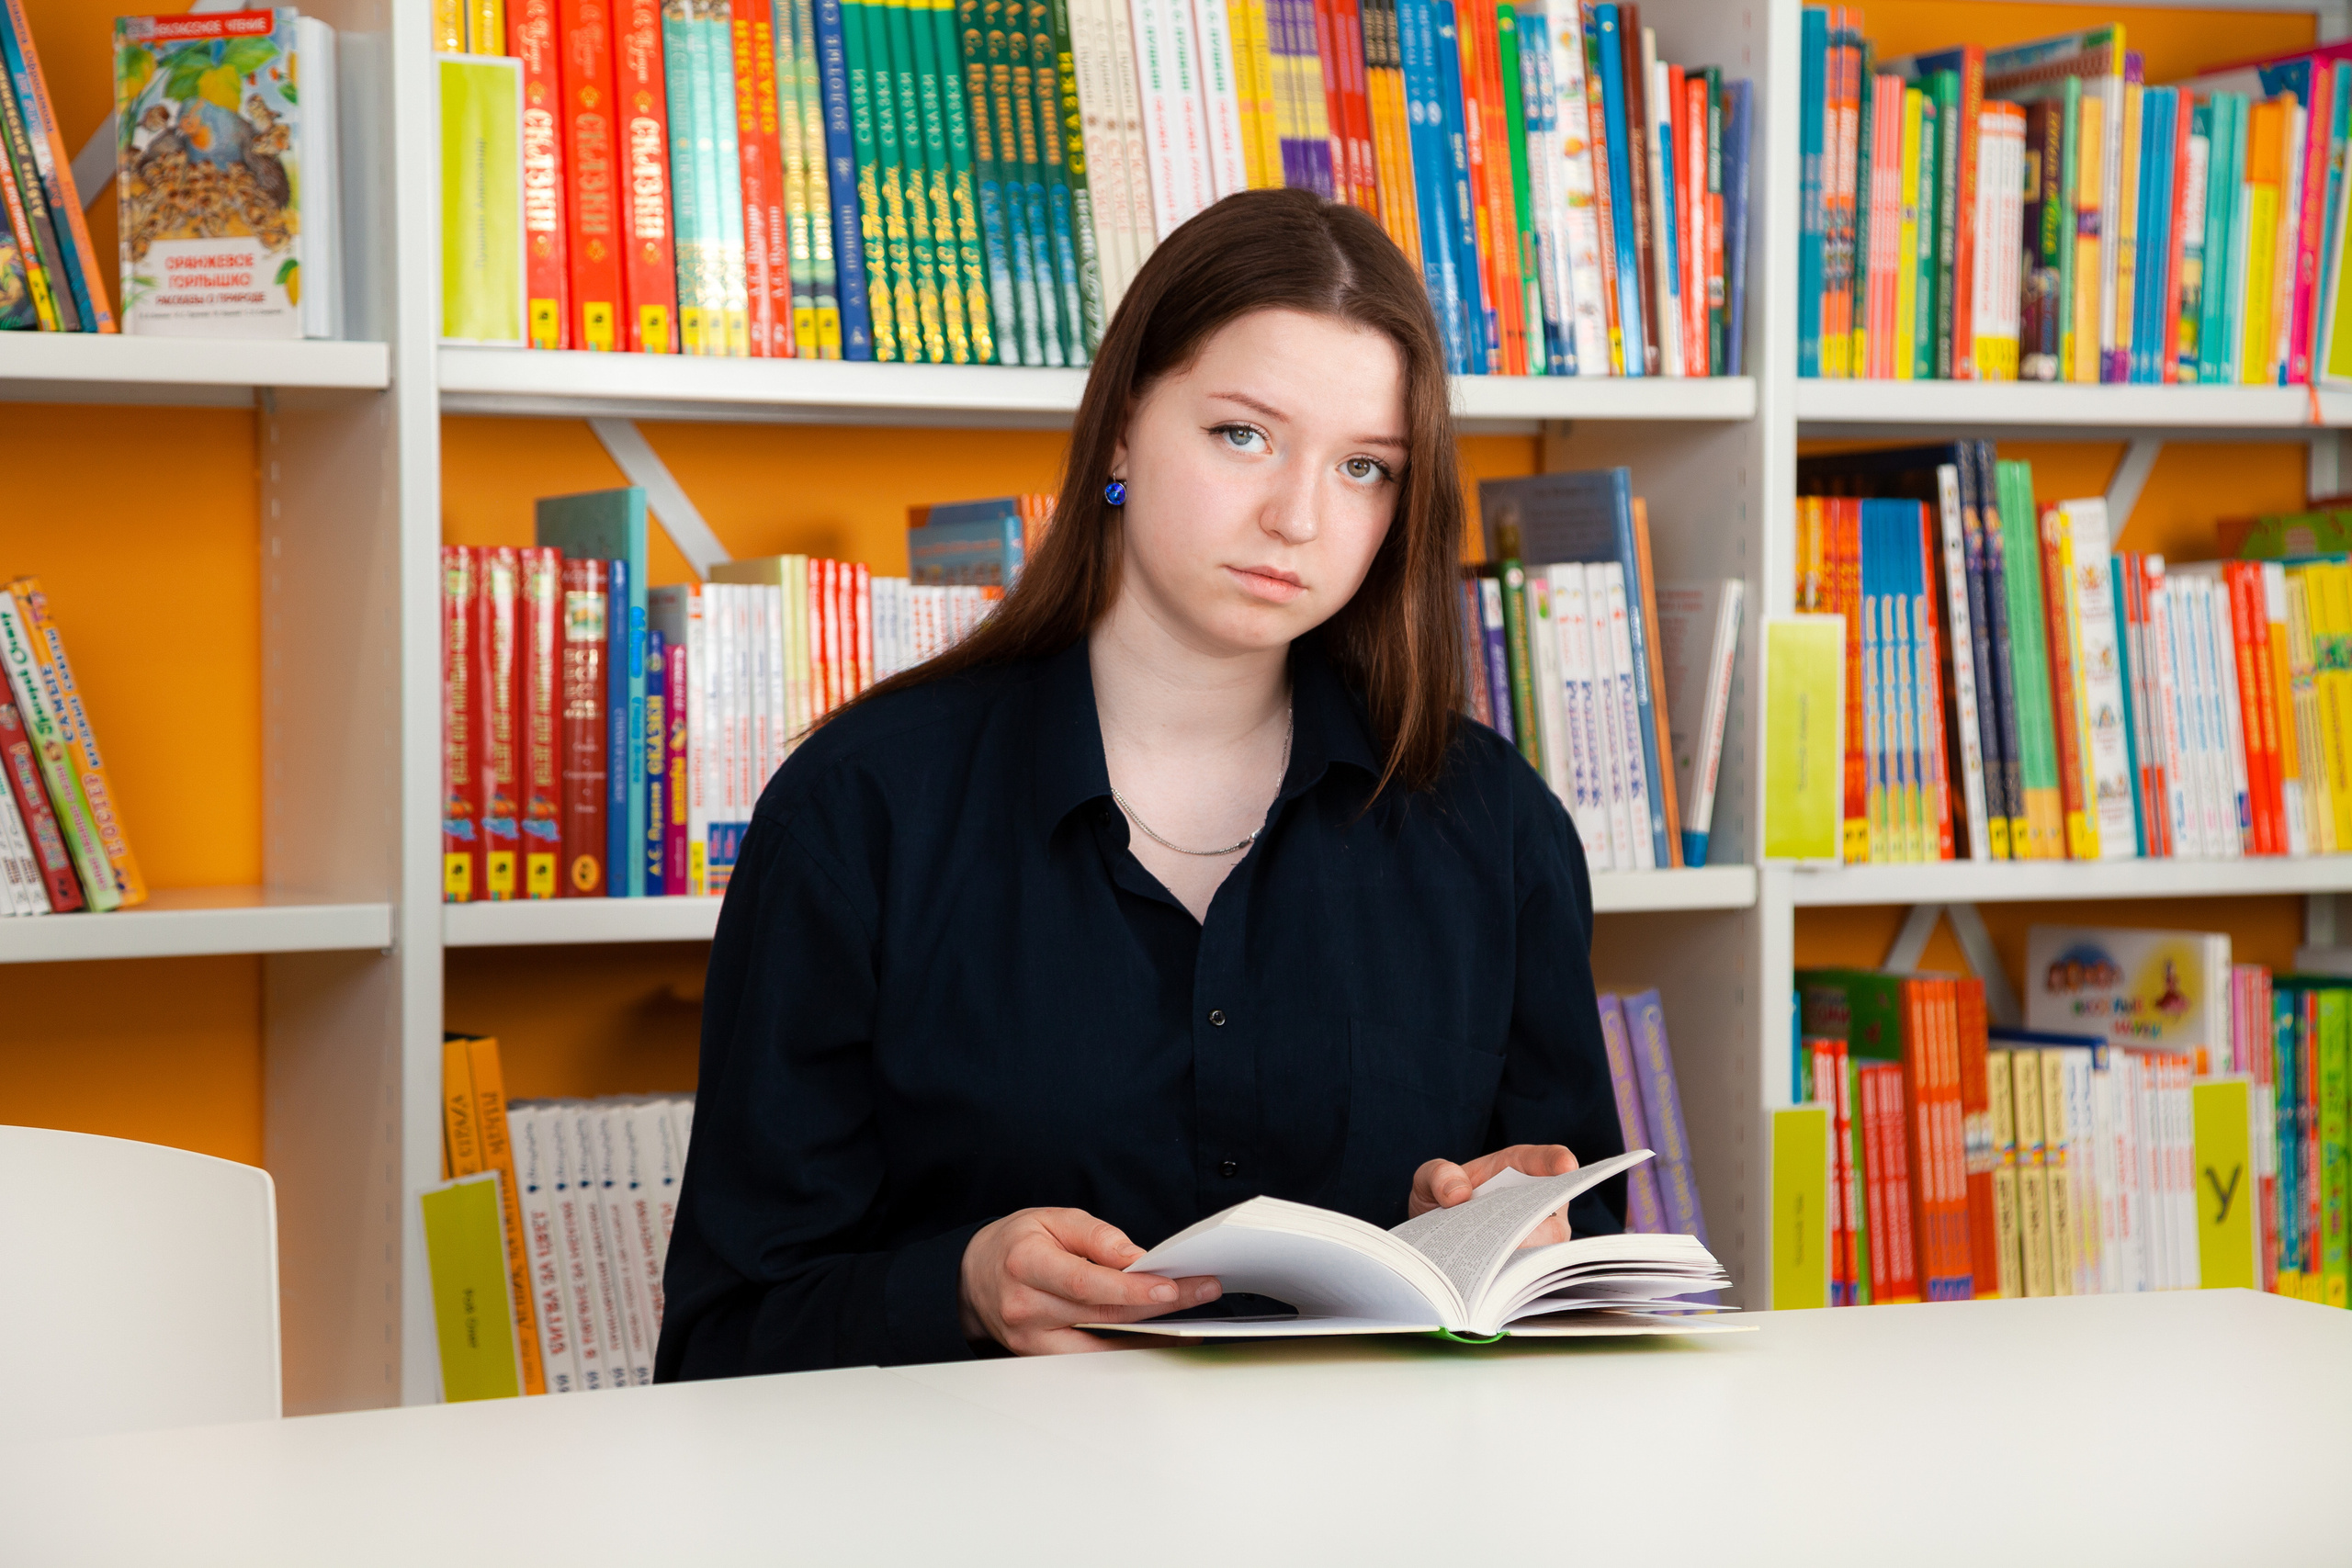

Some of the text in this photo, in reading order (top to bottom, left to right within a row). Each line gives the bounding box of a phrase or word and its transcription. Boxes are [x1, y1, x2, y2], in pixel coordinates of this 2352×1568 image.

[734, 19, 755, 132] СКАЗКИ
[753, 21, 776, 135] СКАЗКИ
[822, 33, 848, 134] ЗОЛОТЫЕ
[854, 69, 871, 145] СКАЗКИ
[876, 71, 895, 147] СКАЗКИ
[899, 72, 920, 149] СКАЗКИ
[922, 73, 942, 151] СКАЗКИ
[946, 74, 967, 152] СКАЗКИ
[967, 62, 993, 162] Пушкин
[992, 63, 1018, 164] Пушкин
[1012, 67, 1039, 164] Пушкин
[1036, 68, 1062, 165] Пушкин
[1056, 51, 1086, 175] СКАЗКИ
[18, 160, 46, 220] Азбука
[523, 107, 556, 231] СКАЗКИ
[577, 110, 610, 234] СКАЗКИ
[629, 115, 664, 239] СКАЗКИ
[165, 253, 254, 271] ОРАНЖЕВОЕ
[168, 272, 252, 289] ГОРЛЫШКО
[1068, 187, 1101, 300] Пушкин
[0, 609, 28, 666] Остер
[18, 667, 54, 737] Григорий
[40, 663, 74, 742] САМЫЕ
[45, 628, 100, 769] ВРЕДНЫЕ СОВЕТЫ
[648, 694, 668, 774] СКАЗКИ
